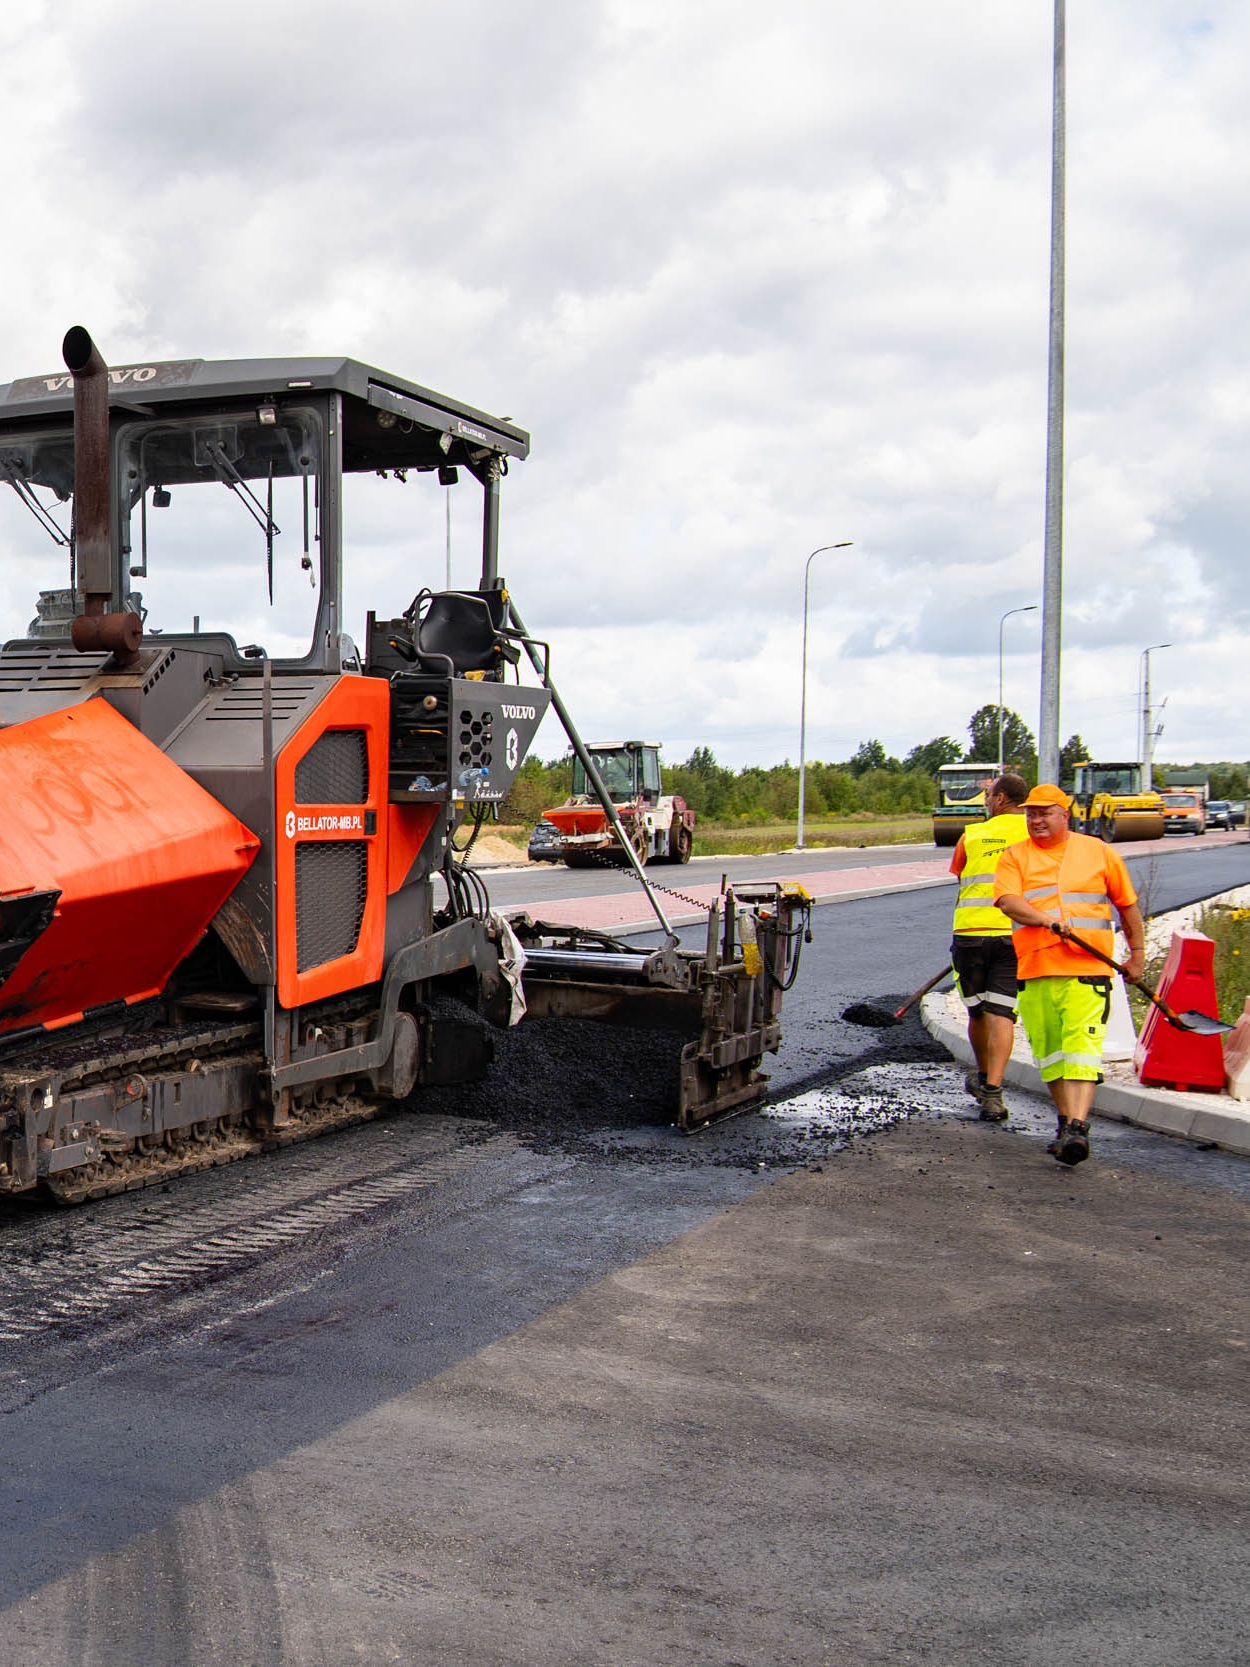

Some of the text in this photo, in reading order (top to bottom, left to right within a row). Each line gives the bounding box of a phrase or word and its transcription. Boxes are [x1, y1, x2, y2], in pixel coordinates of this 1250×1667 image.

[43, 367, 157, 391] VVO
[501, 704, 536, 720] VOLVO
[297, 815, 363, 831] BELLATOR-MB.PL
